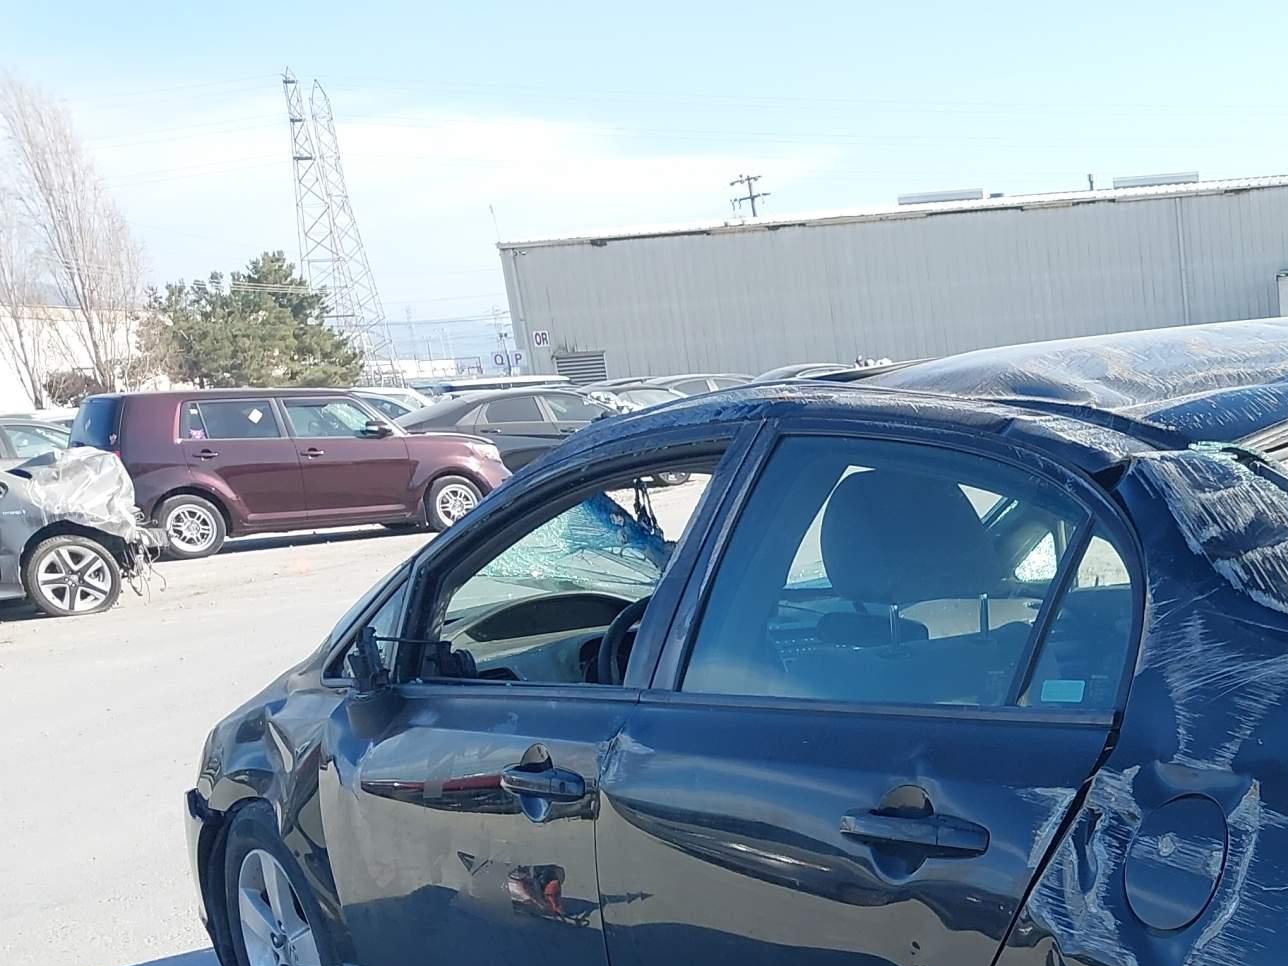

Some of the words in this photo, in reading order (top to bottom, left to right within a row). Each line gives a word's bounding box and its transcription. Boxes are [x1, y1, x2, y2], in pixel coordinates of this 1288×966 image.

[534, 332, 549, 346] OR
[494, 353, 505, 366] Q
[514, 353, 523, 366] P
